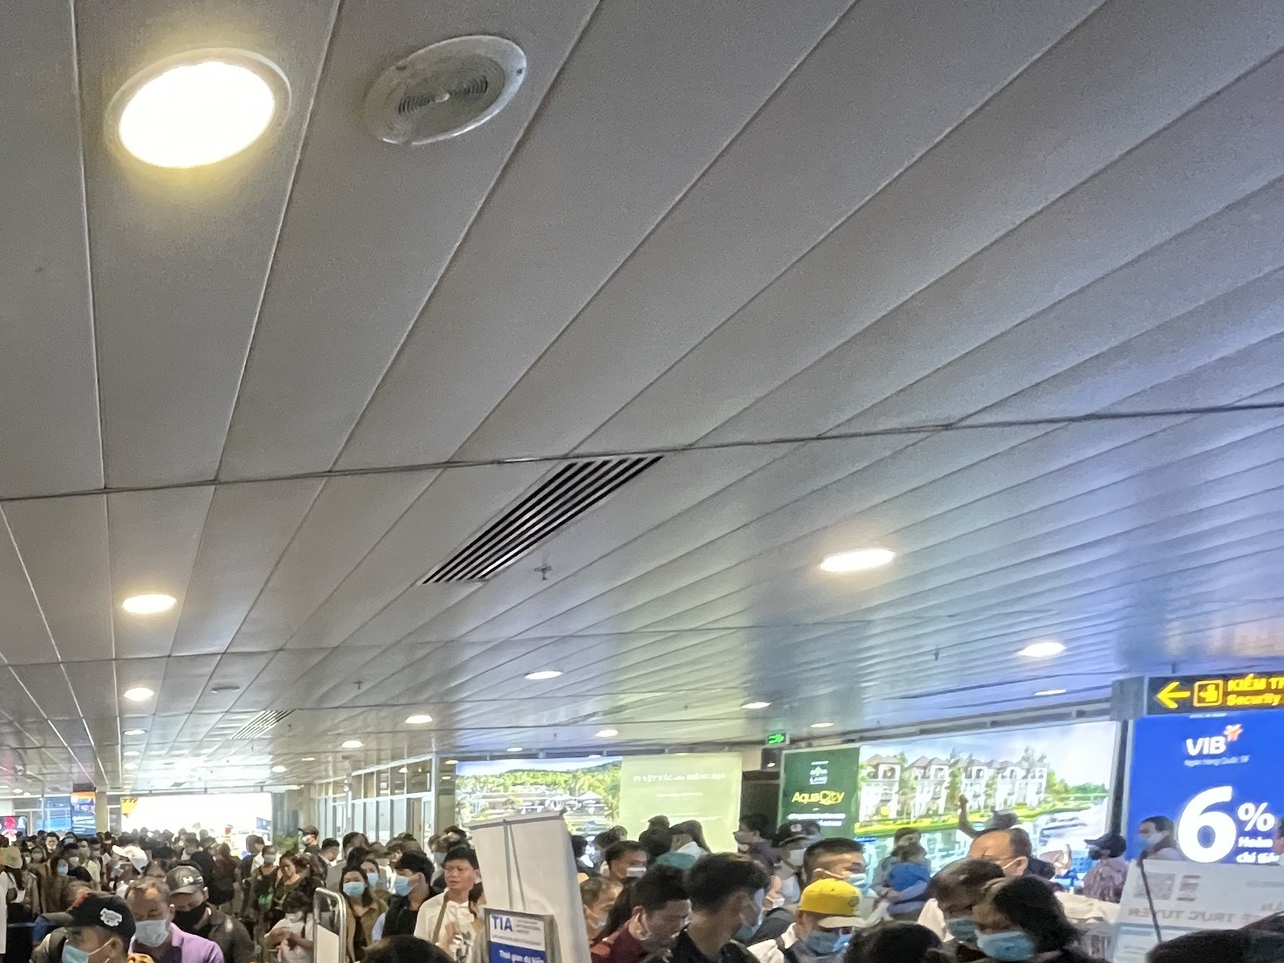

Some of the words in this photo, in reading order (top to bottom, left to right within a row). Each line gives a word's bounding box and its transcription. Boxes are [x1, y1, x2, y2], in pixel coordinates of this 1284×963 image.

[1226, 693, 1281, 706] Security
[1186, 736, 1226, 756] VIB
[792, 790, 844, 805] AquaCity
[492, 914, 513, 932] TIA
